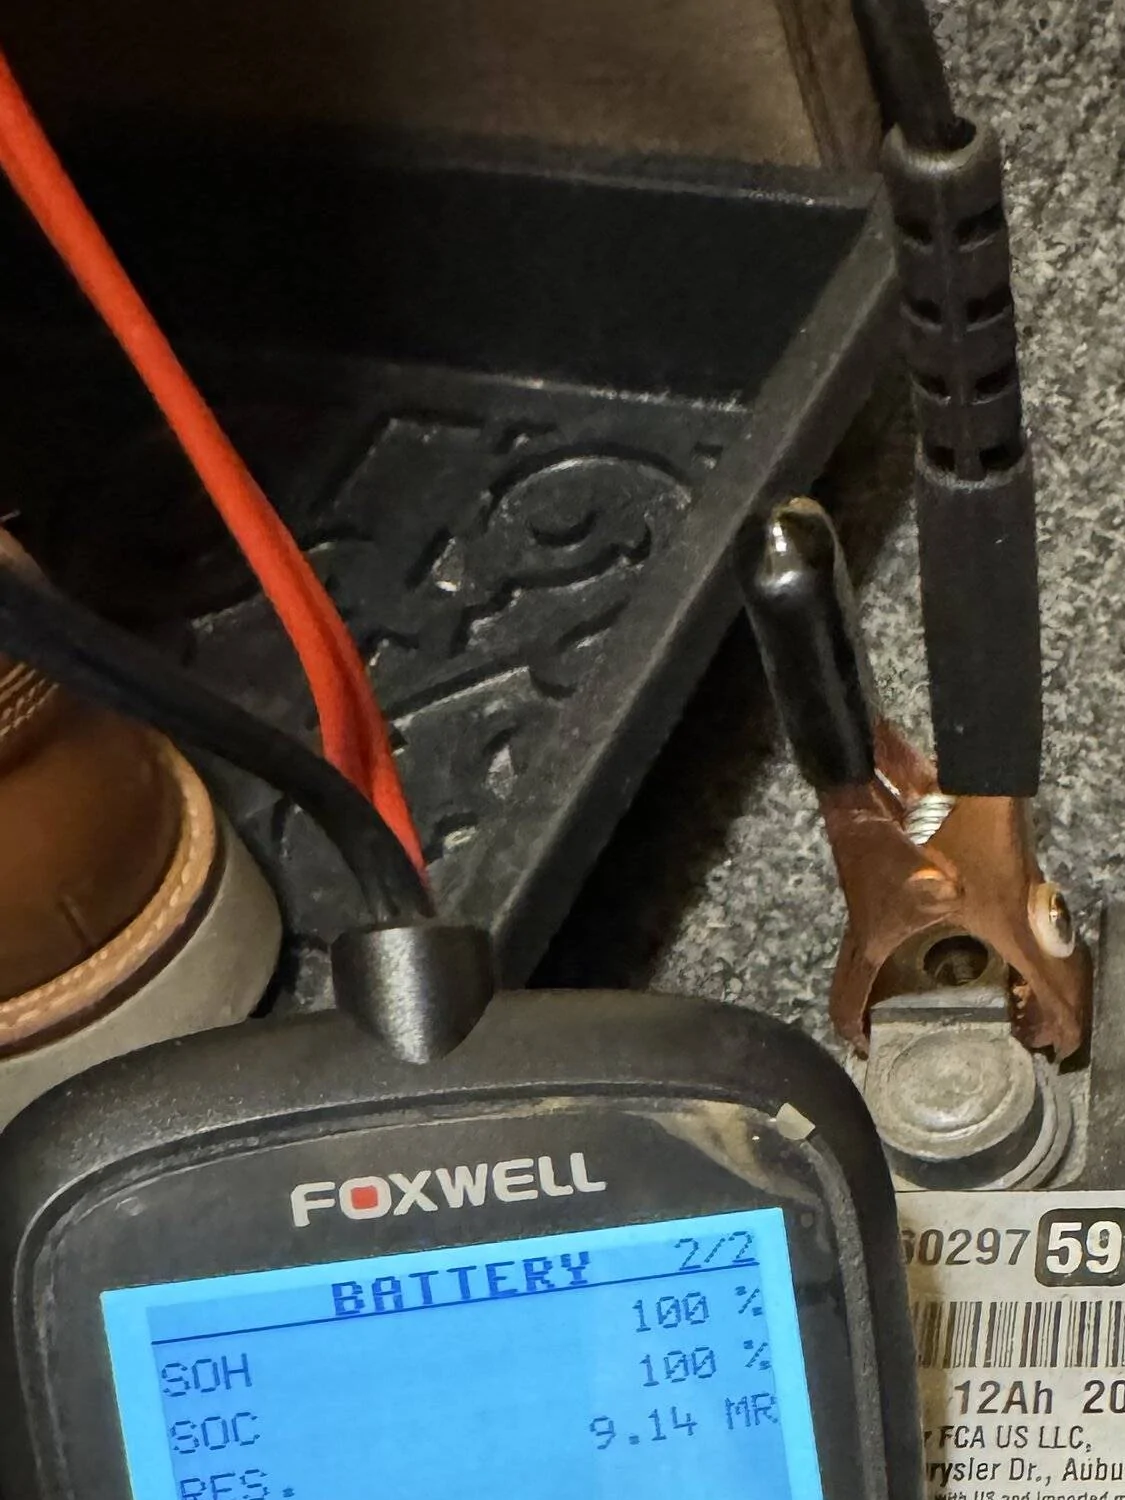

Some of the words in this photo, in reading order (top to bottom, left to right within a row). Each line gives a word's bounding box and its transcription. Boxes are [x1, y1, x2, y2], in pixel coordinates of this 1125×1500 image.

[291, 1152, 607, 1228] FOXWELL
[331, 1250, 592, 1318] BATTERY
[673, 1230, 760, 1273] 2/2
[632, 1291, 710, 1333] 100
[734, 1285, 765, 1317] %
[160, 1352, 252, 1398] SOH
[639, 1345, 718, 1388] 100
[743, 1339, 772, 1371] %
[952, 1380, 1054, 1416] 12Ah
[169, 1409, 261, 1455] SOC
[588, 1407, 698, 1451] 9.14
[939, 1425, 986, 1449] FCA
[996, 1425, 1029, 1449] US
[1039, 1425, 1092, 1453] LLC,
